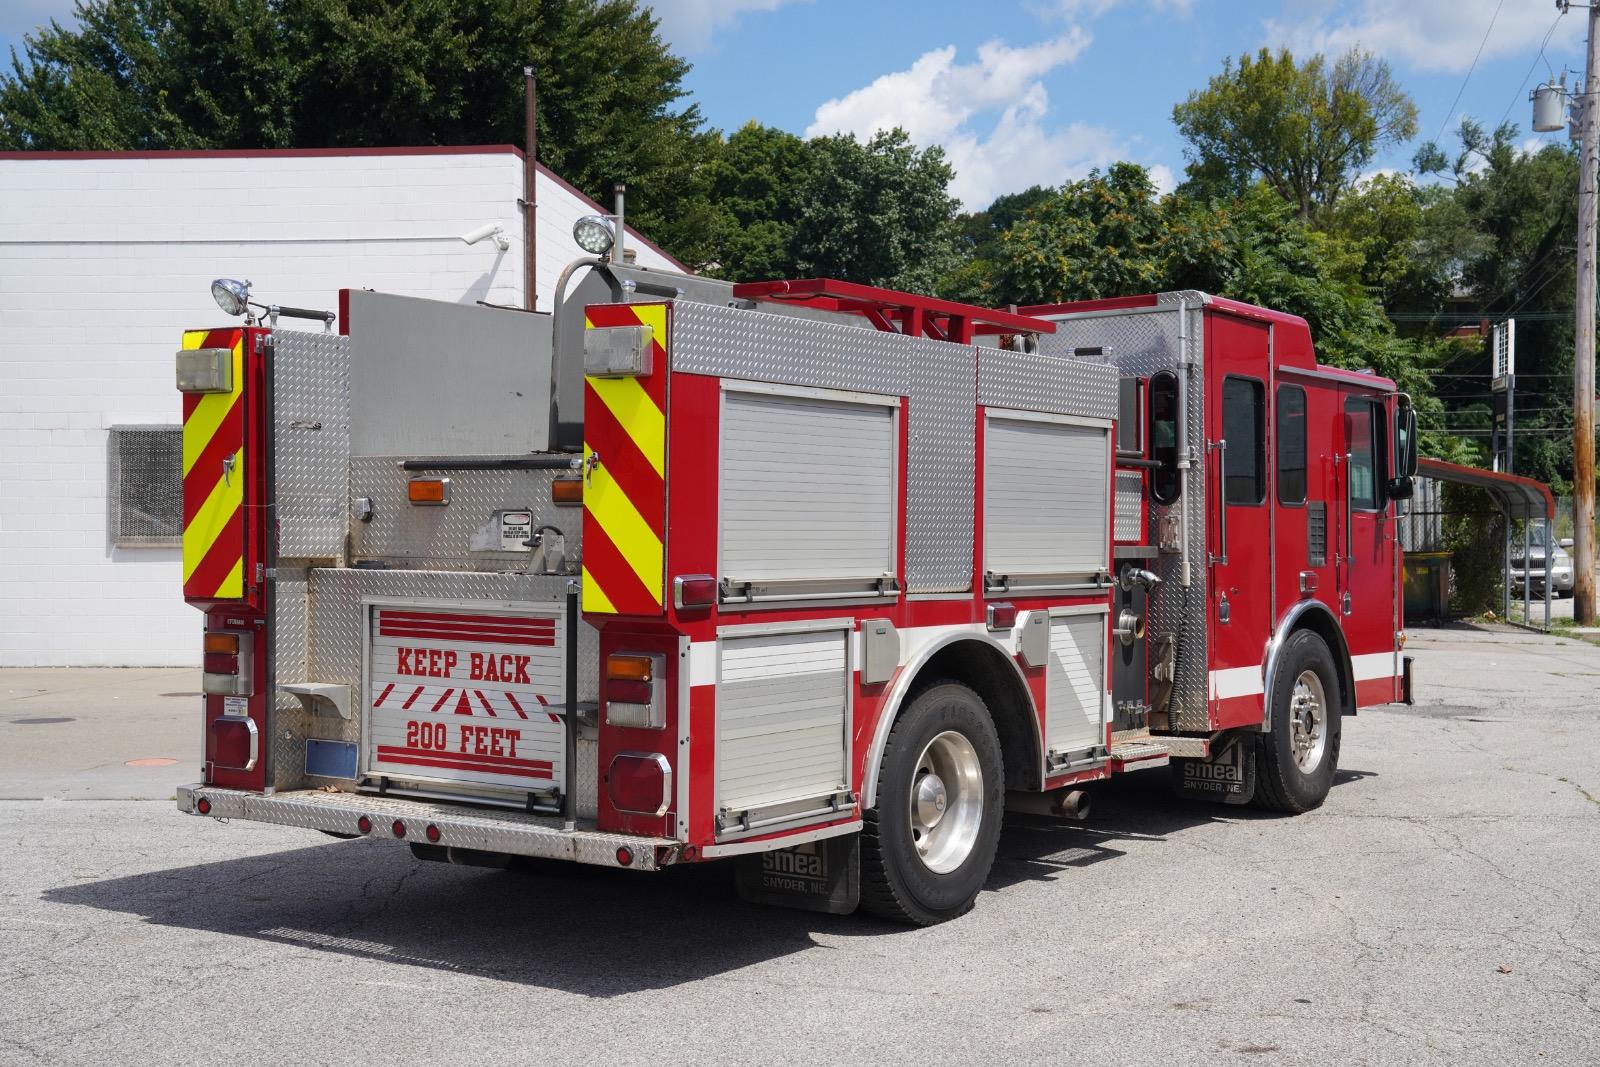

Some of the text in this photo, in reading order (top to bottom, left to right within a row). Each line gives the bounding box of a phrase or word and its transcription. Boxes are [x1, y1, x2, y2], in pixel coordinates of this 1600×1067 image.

[397, 647, 531, 684] KEEP BACK
[406, 720, 521, 757] 200 FEET
